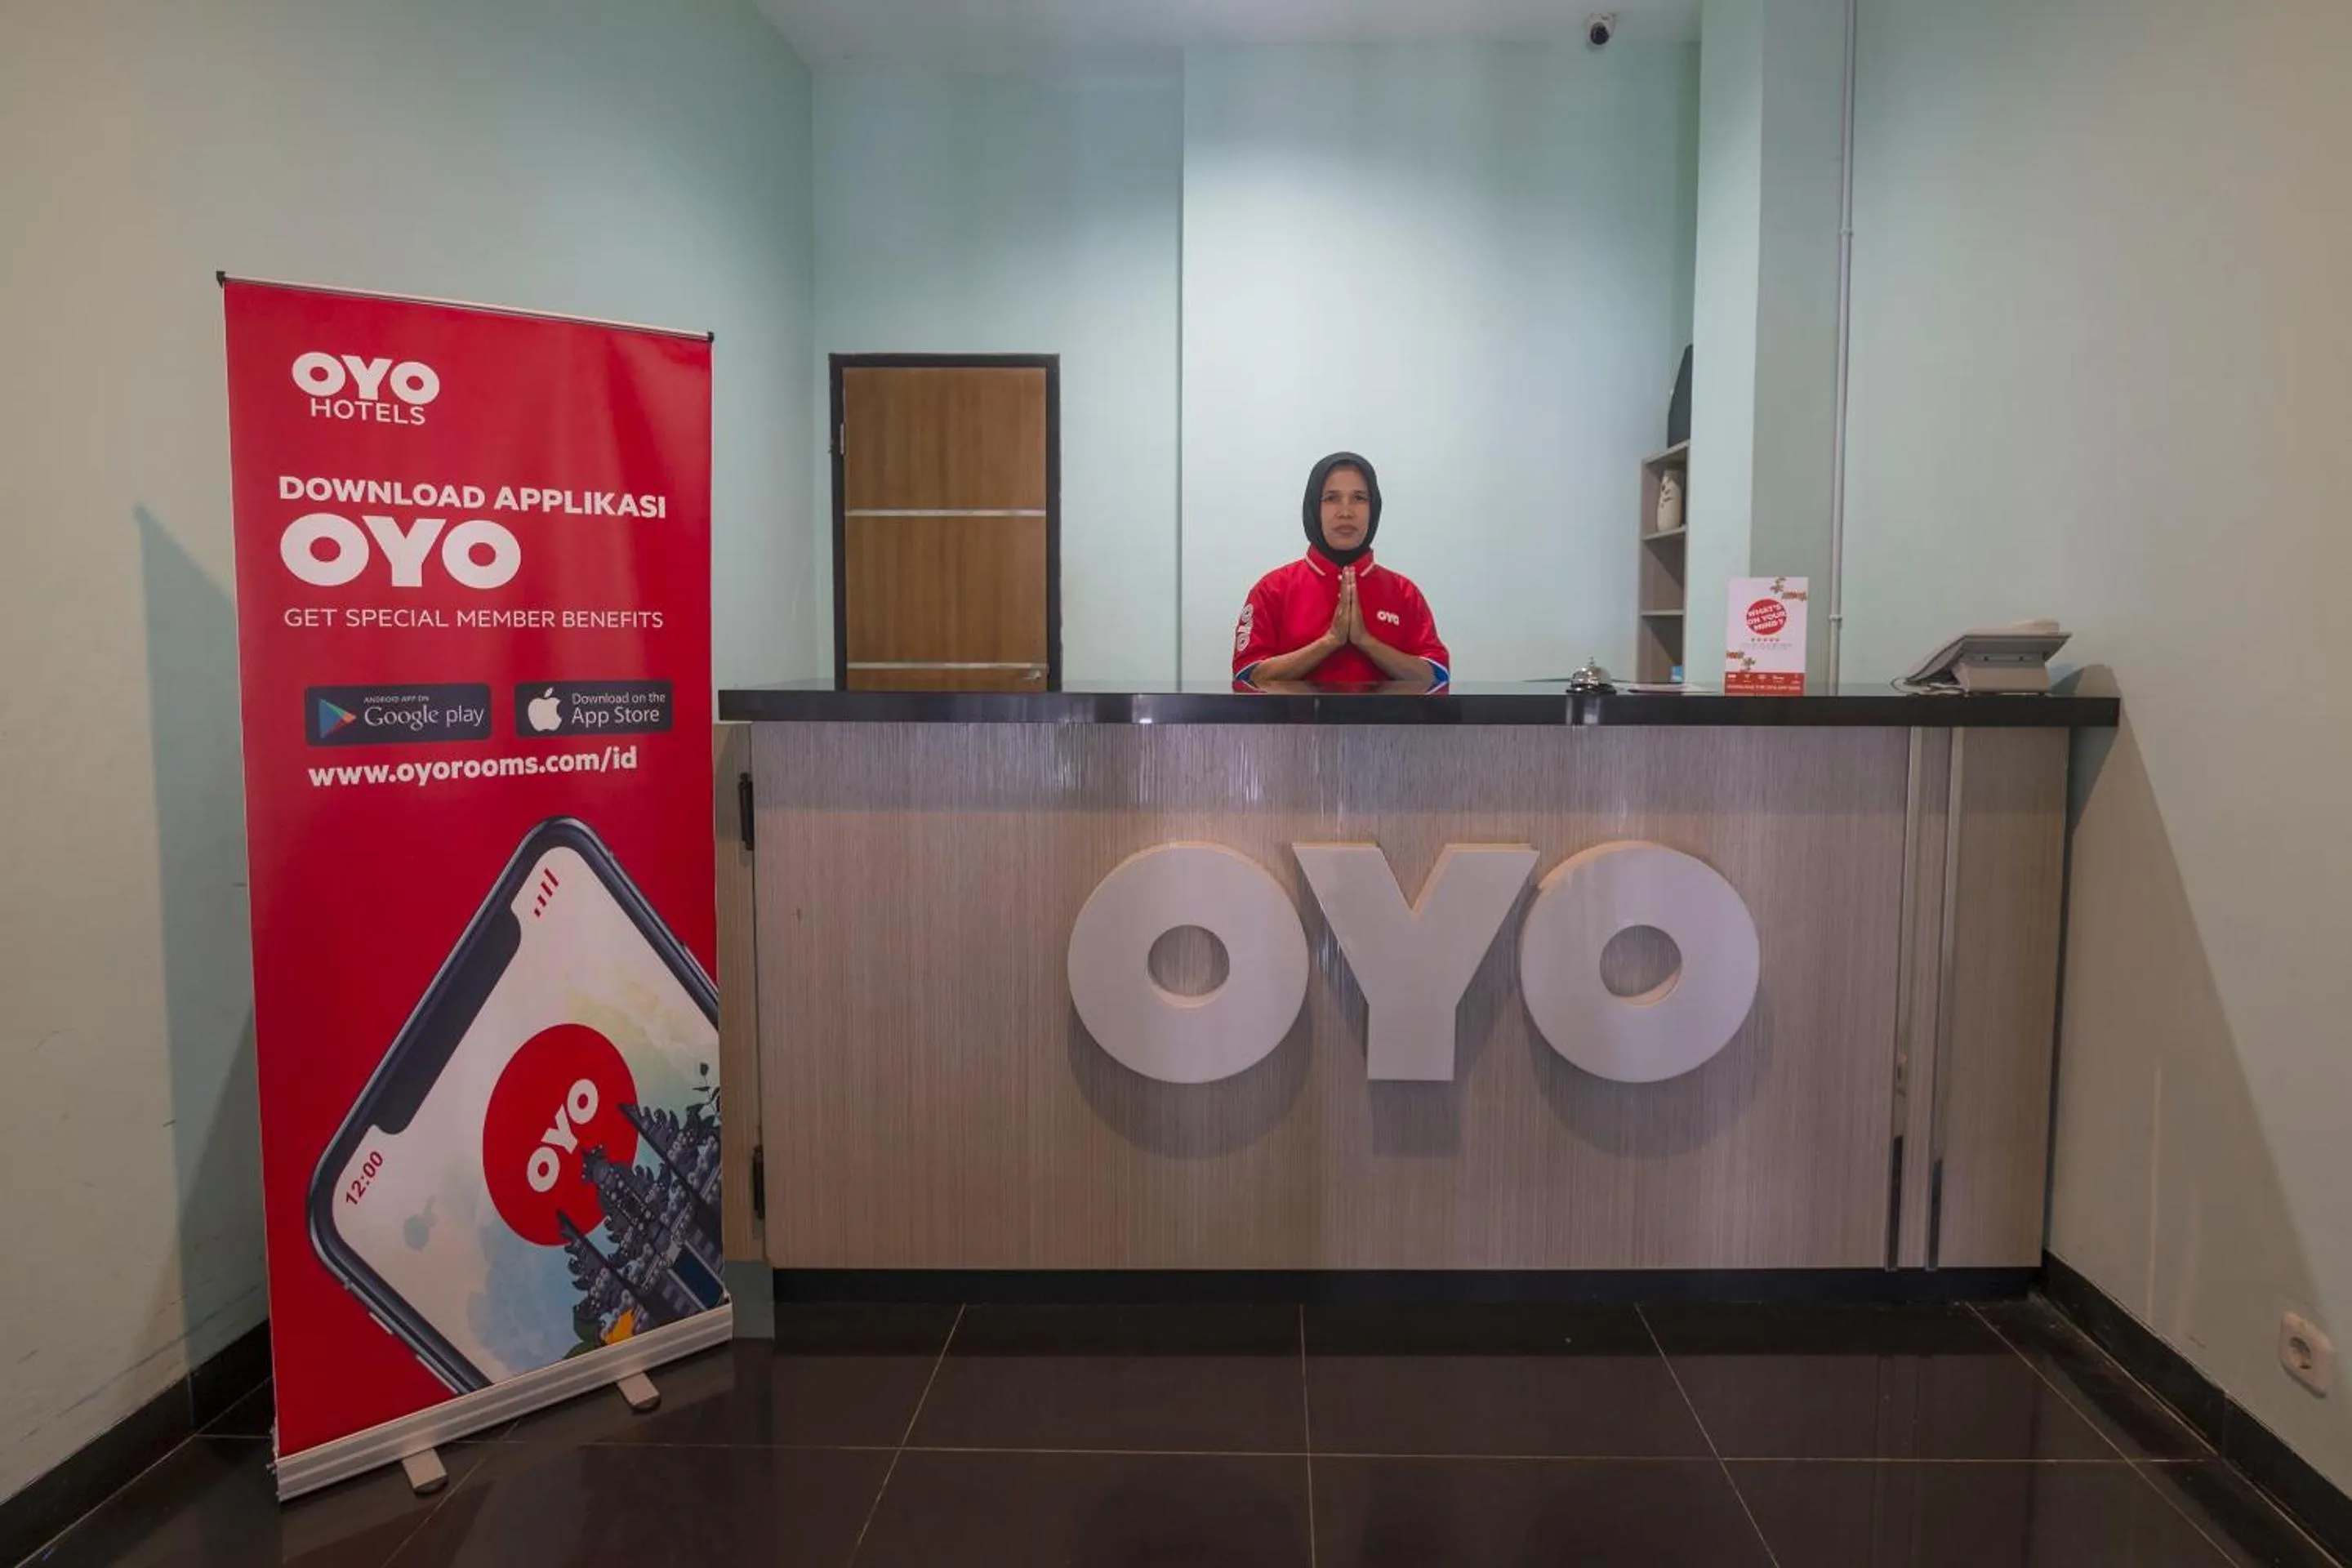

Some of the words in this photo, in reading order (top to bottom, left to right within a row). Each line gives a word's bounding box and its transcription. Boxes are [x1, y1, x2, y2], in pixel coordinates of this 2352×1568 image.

[292, 351, 439, 404] OYO
[311, 398, 425, 425] HOTELS
[279, 475, 485, 509] DOWNLOAD
[494, 487, 666, 519] APPLIKASI
[280, 513, 521, 589] OYO
[284, 608, 337, 628] GET
[345, 608, 448, 628] SPECIAL
[457, 610, 555, 628] MEMBER
[563, 611, 664, 629] BENEFITS
[1377, 611, 1399, 626] OYO
[364, 705, 439, 731] Google
[447, 705, 484, 727] play
[572, 693, 628, 705] Download
[631, 695, 646, 703] on
[648, 692, 666, 703] the
[572, 707, 609, 728] App
[614, 706, 659, 724] Store
[309, 746, 637, 786] www.oyorooms.com/id
[1067, 840, 1760, 1083] OYO
[527, 1078, 599, 1192] OYO
[345, 1151, 384, 1206] 12:00
